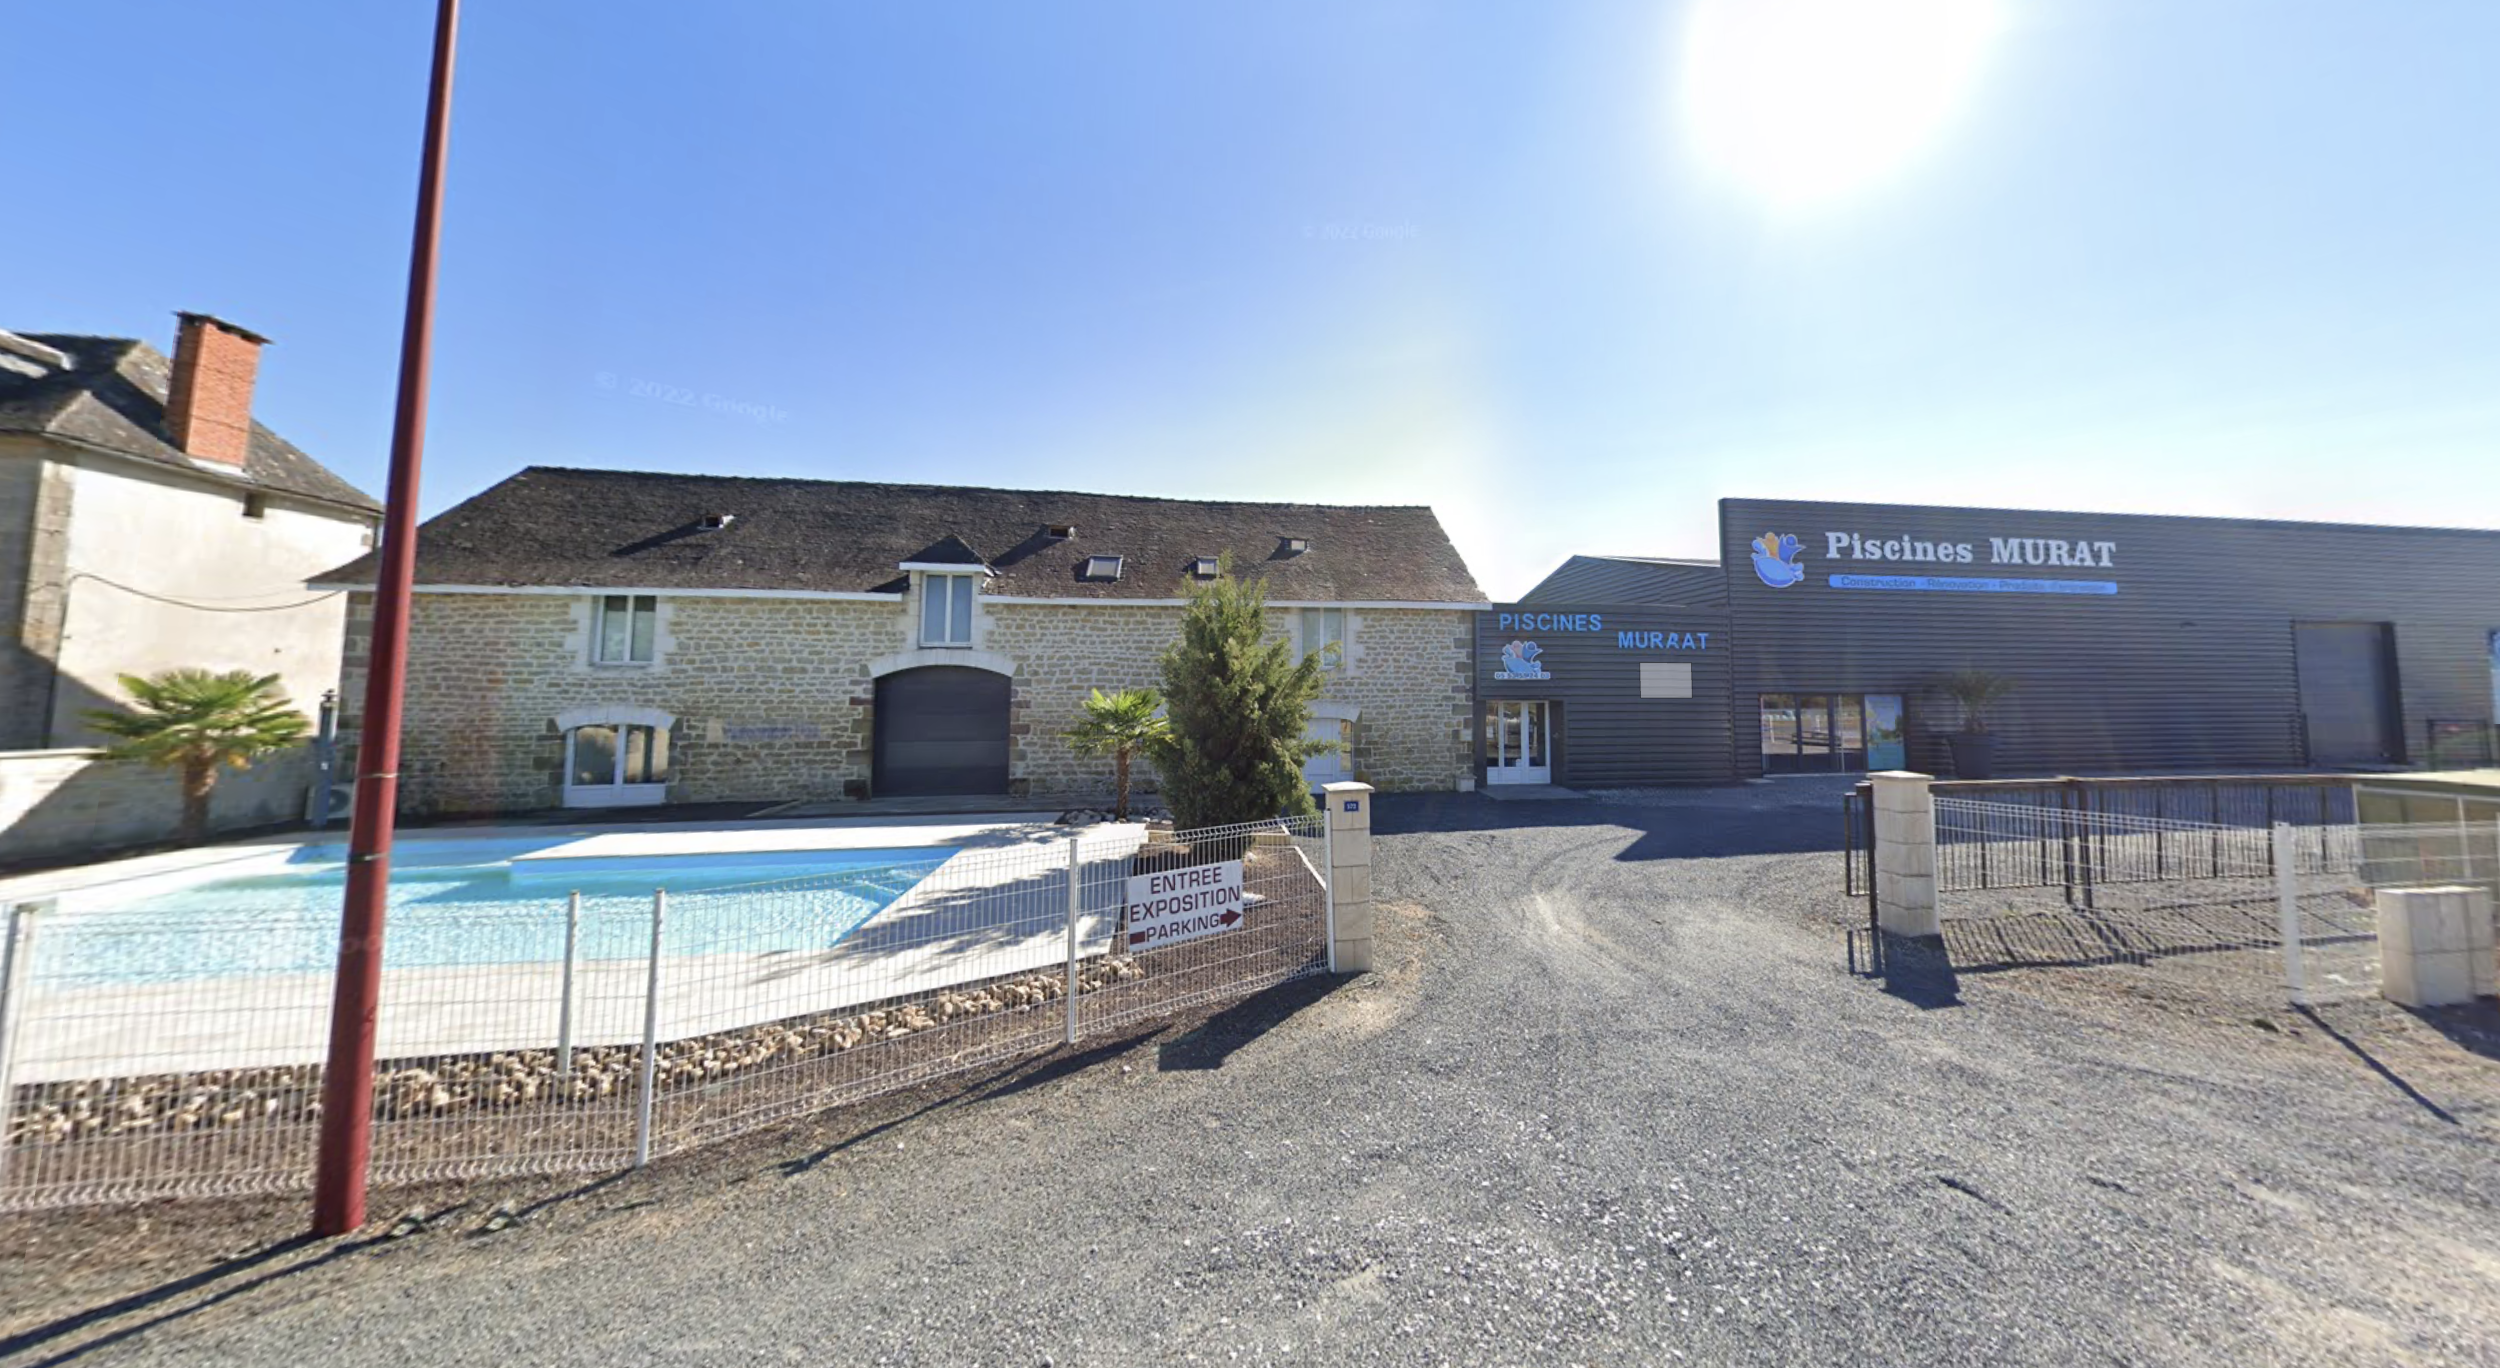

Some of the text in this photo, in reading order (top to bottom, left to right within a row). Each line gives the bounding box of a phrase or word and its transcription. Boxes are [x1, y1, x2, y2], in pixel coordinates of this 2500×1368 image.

[1825, 531, 2117, 567] Piscines MURAT
[1841, 575, 1917, 588] Construction
[1500, 613, 1603, 632] PISCINES
[1150, 866, 1223, 895] ENTREE
[1130, 885, 1241, 923] EXPOSITION
[1146, 913, 1220, 943] PARKING
